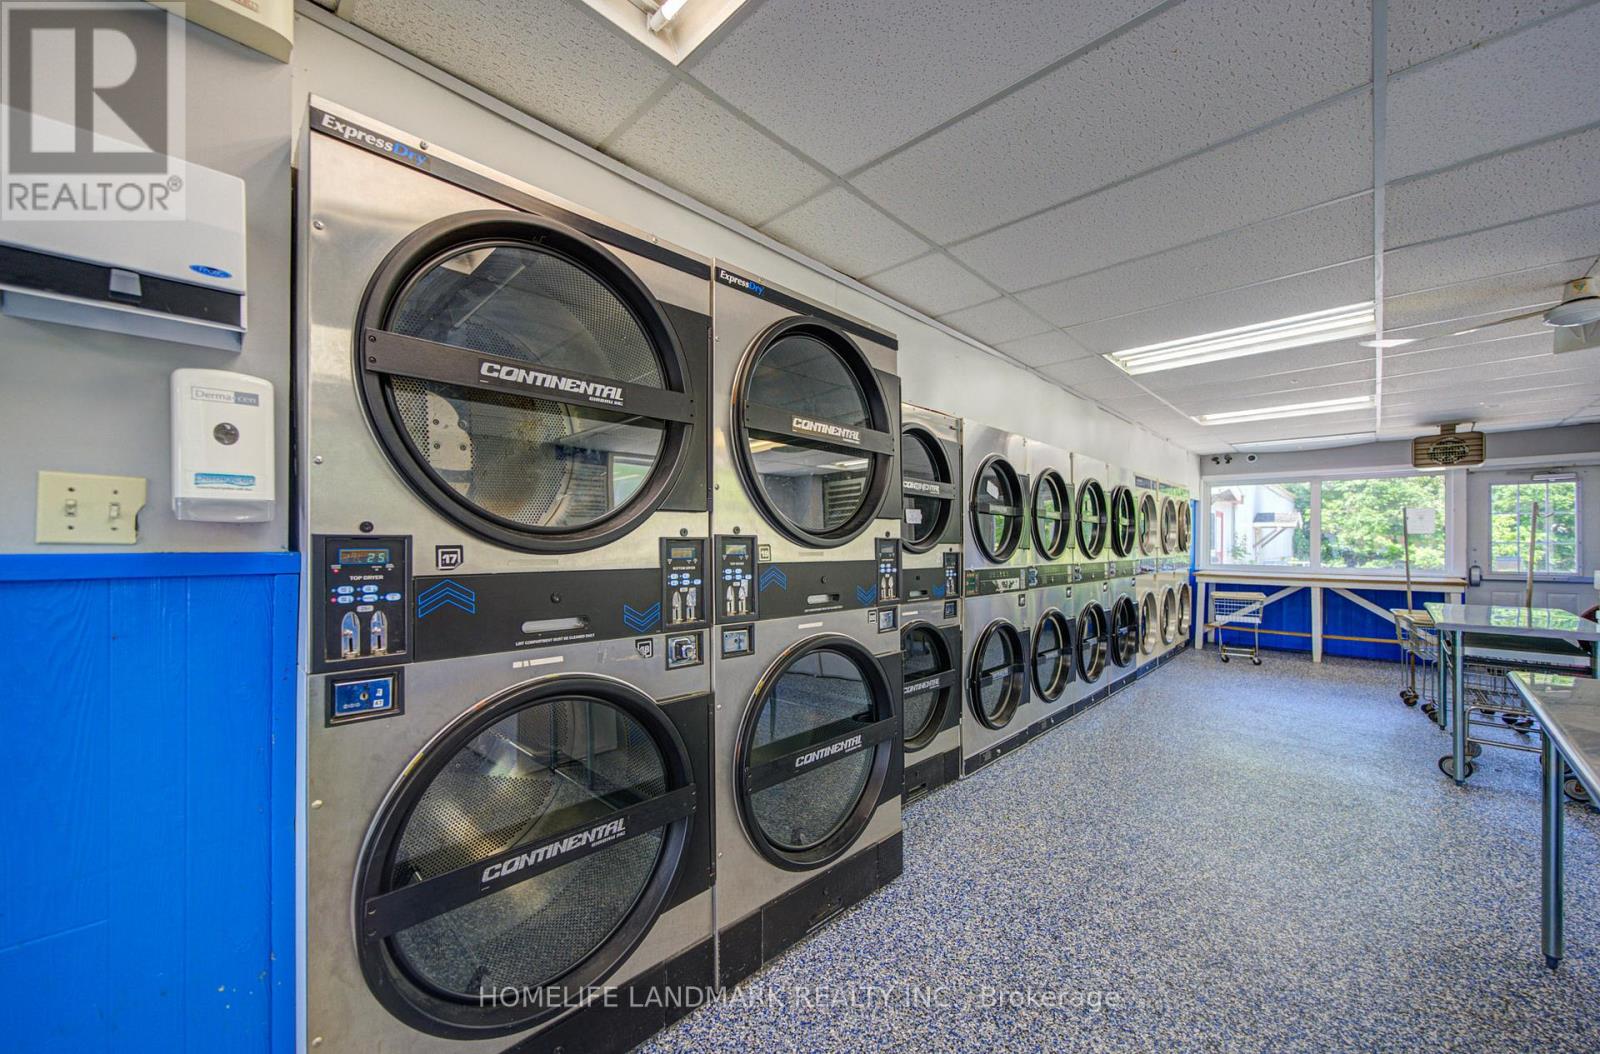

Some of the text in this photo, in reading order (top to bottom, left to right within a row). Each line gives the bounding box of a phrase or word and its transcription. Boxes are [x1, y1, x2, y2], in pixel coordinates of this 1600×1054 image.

[321, 113, 428, 166] ExpressDry
[720, 270, 764, 295] ExpressDry
[480, 362, 624, 400] CONTINENTAL
[792, 417, 861, 440] CONTINENTAL
[795, 734, 862, 767] CONTINENTAL
[481, 817, 626, 883] CONTINENTAL
